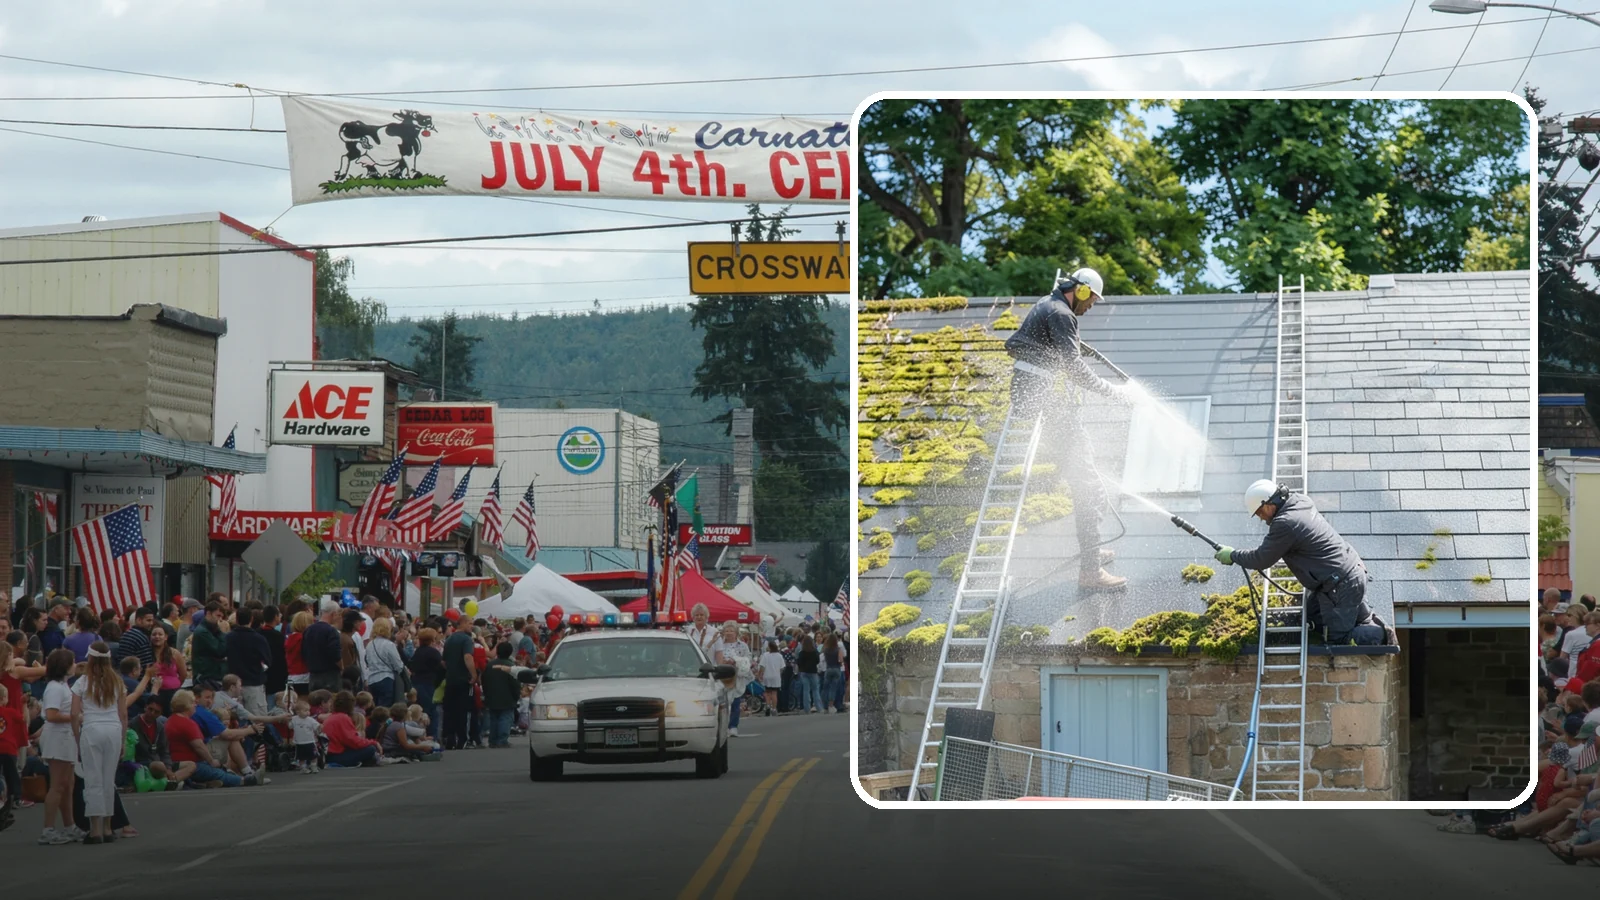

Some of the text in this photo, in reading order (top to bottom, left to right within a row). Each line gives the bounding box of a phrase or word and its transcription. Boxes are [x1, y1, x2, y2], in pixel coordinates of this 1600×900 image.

[481, 141, 605, 192] JULY
[632, 150, 746, 197] 4th.
[697, 254, 850, 280] CROSSWA
[282, 380, 373, 420] ACE
[405, 409, 485, 422] CEDAR LOG
[283, 421, 371, 436] Hardware
[96, 485, 124, 494] Vincent
[126, 486, 135, 494] de
[138, 486, 155, 495] Paul
[688, 526, 741, 535] CRNATION
[699, 535, 730, 543] GLASS
